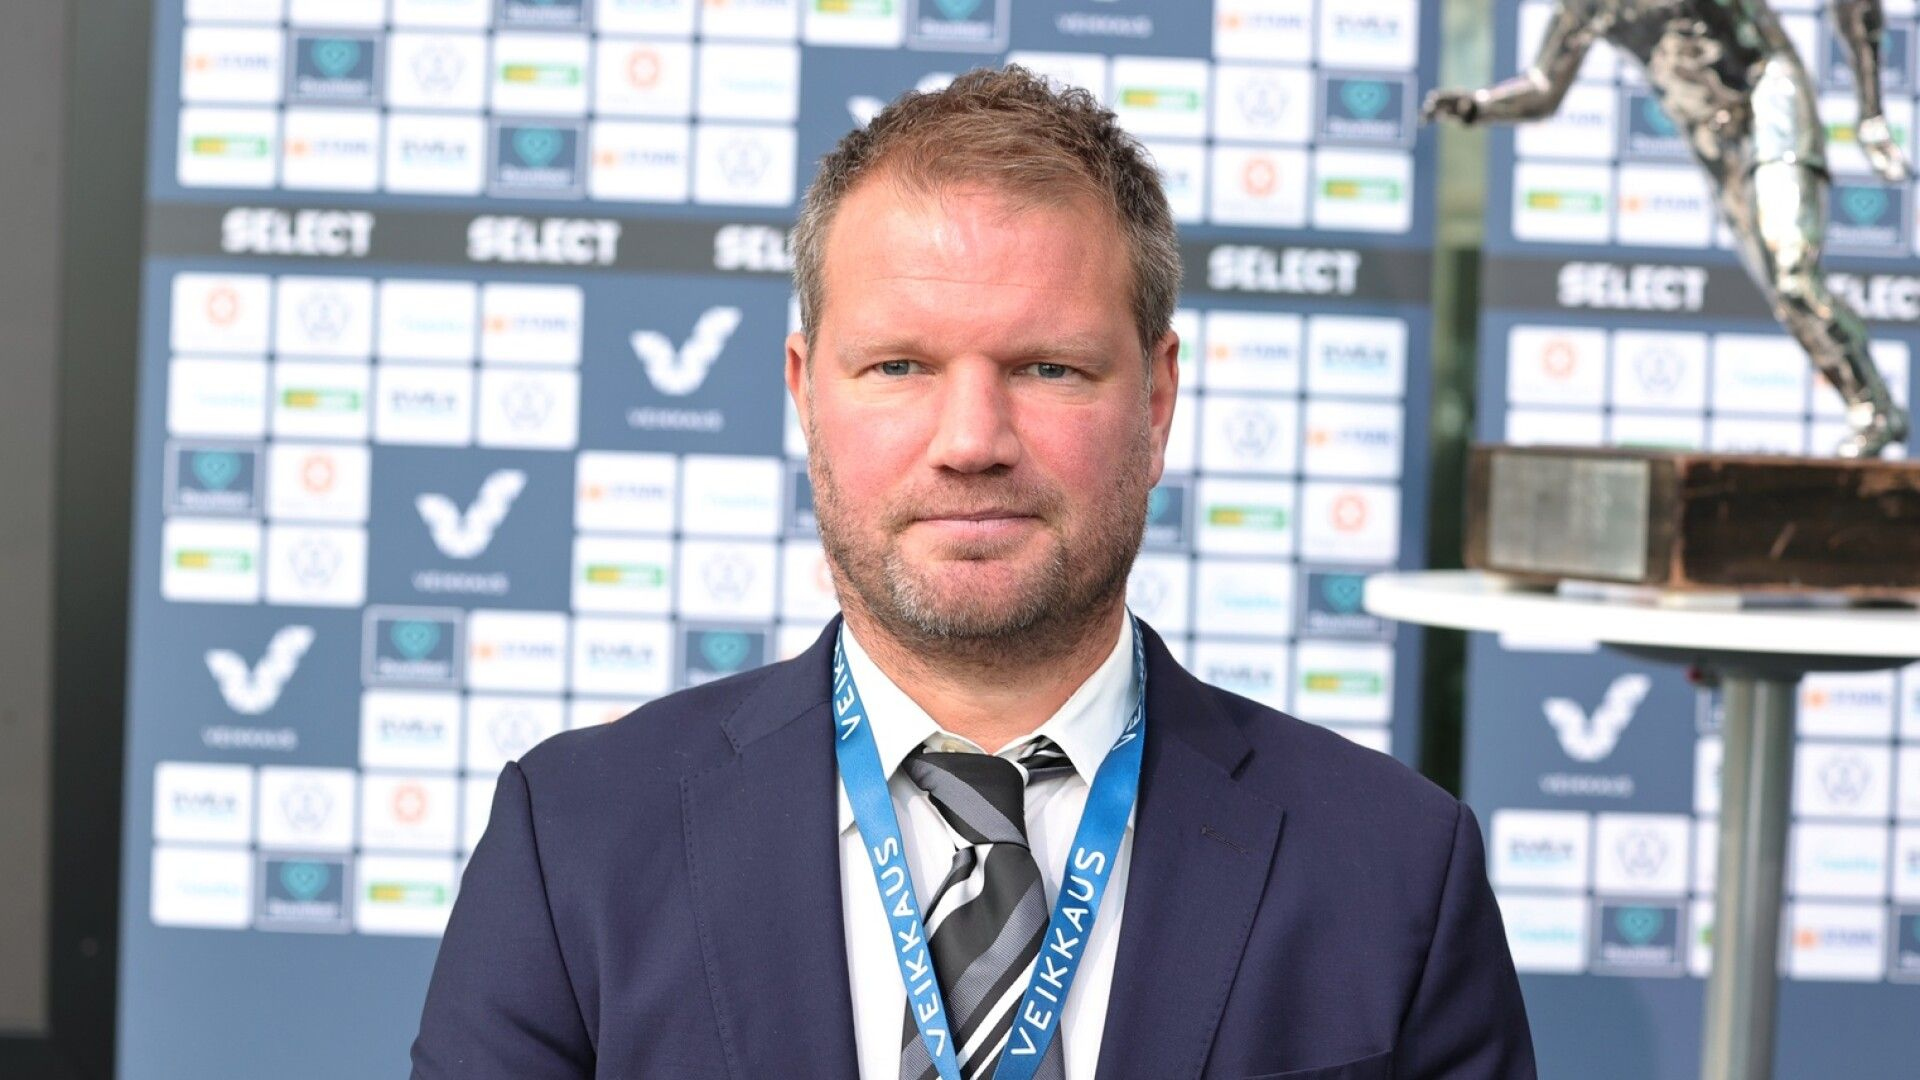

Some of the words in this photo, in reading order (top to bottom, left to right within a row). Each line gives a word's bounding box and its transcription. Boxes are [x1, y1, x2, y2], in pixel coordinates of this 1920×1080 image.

[221, 208, 373, 256] SELECT
[467, 215, 621, 265] SELECT
[714, 224, 795, 271] SEL
[1208, 246, 1359, 294] SELECT
[1557, 262, 1706, 311] SELECT
[873, 836, 945, 1057] VEIKKAUS
[1011, 847, 1106, 1057] VEIKKAUS
